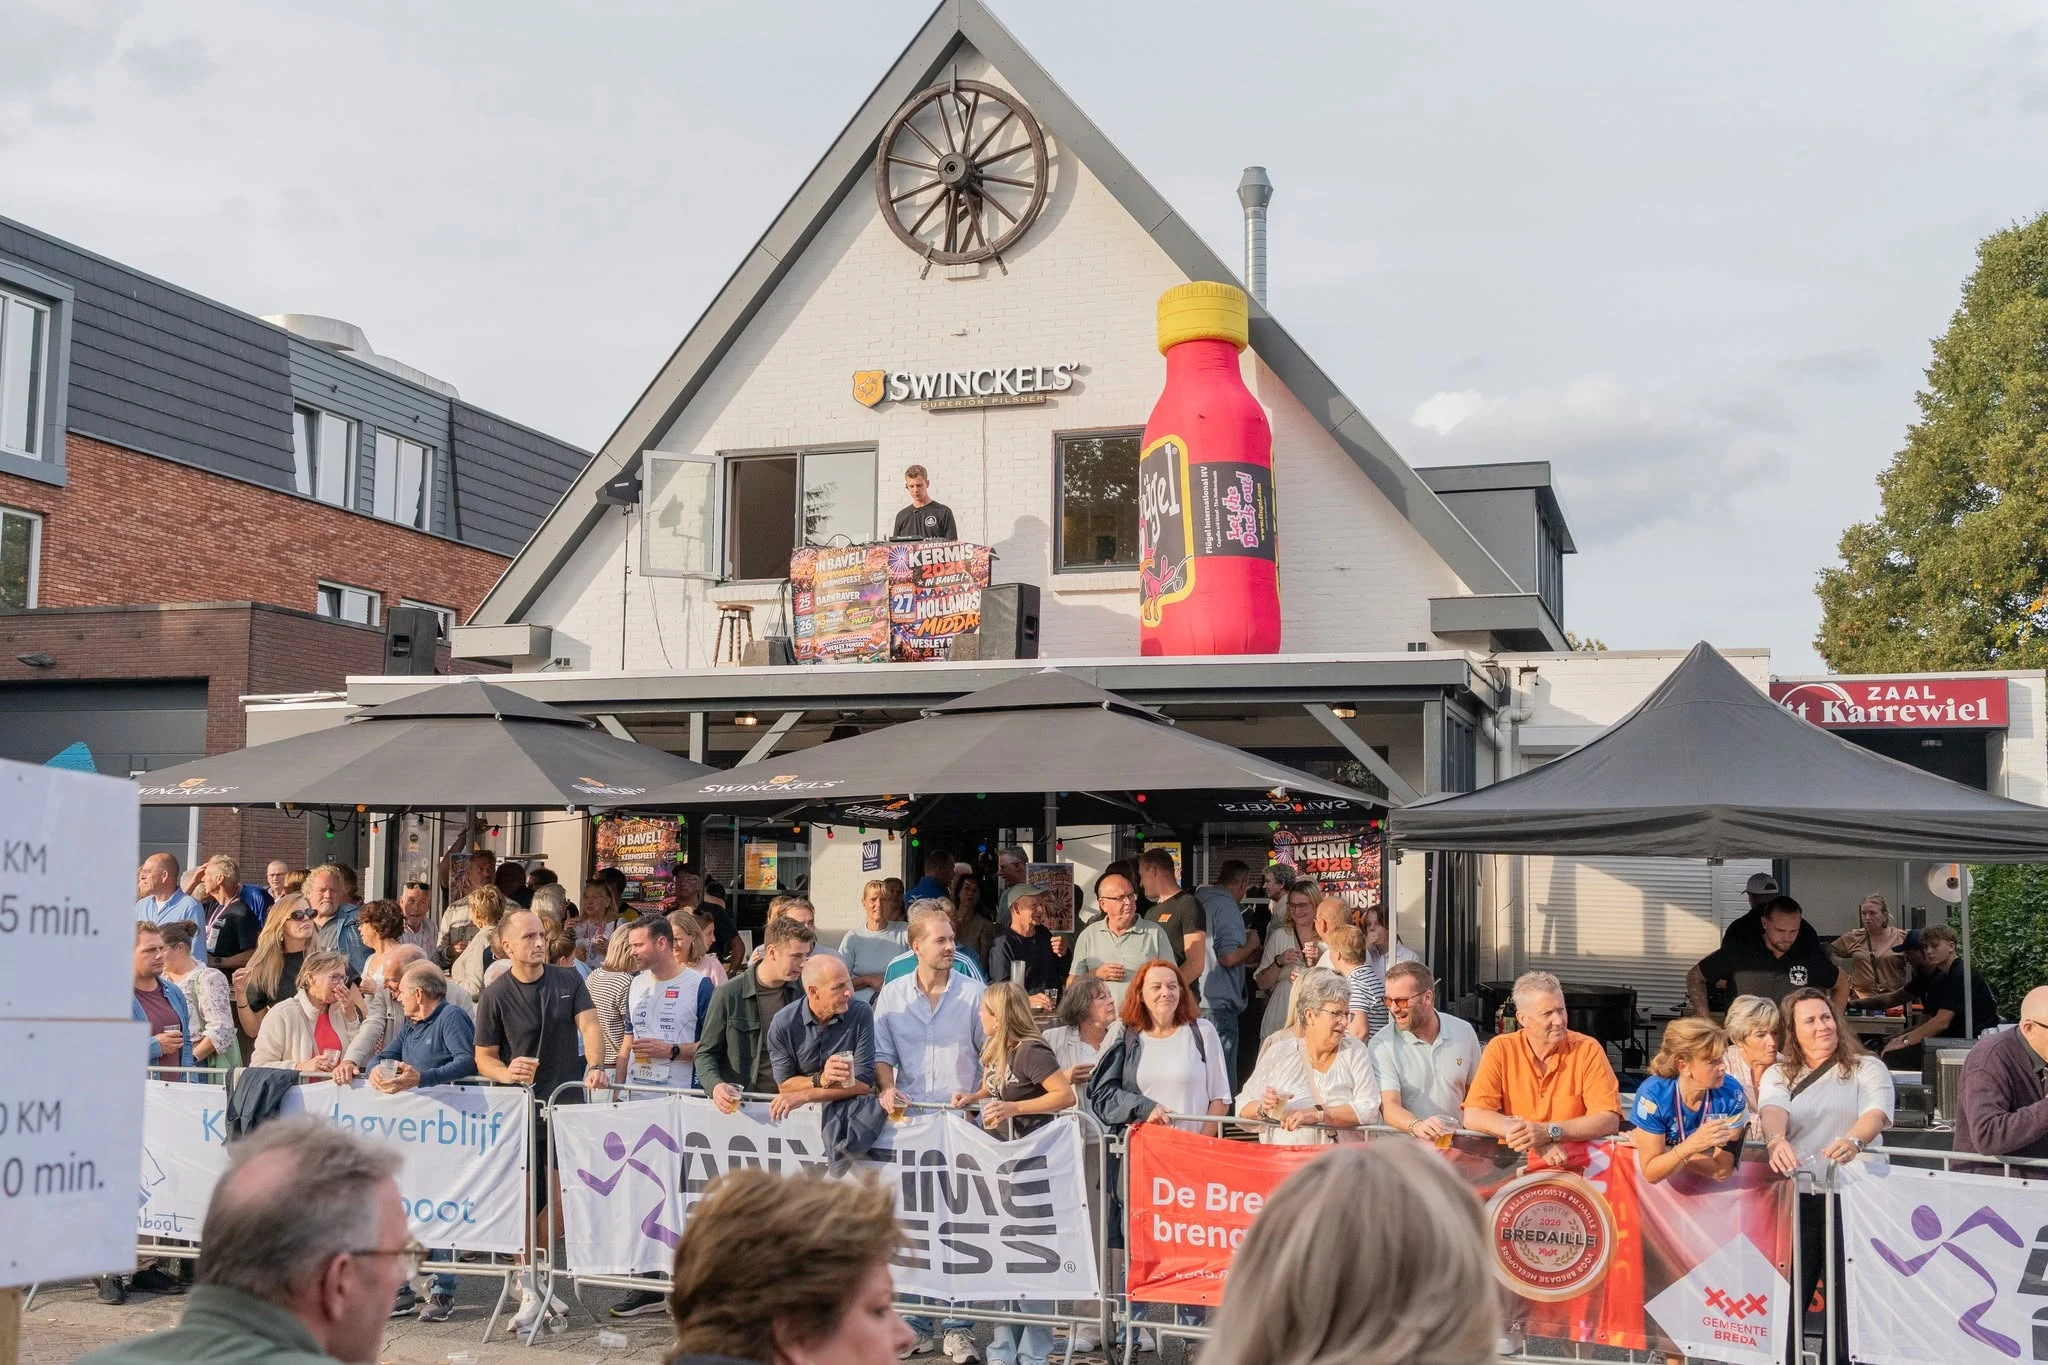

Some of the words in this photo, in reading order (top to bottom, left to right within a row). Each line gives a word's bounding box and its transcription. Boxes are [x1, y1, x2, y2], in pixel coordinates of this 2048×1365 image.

[889, 360, 1079, 401] SWINCKELS'
[921, 399, 985, 410] SUPERIOR
[992, 395, 1044, 404] PILSNER
[1200, 466, 1209, 478] NV
[1236, 471, 1253, 503] out!
[1201, 478, 1211, 529] International
[1222, 486, 1241, 512] the
[1226, 514, 1241, 540] Let
[1240, 504, 1259, 548] Duck
[1205, 529, 1214, 554] Flügel
[815, 560, 826, 573] IN
[828, 550, 867, 570] BAVEL!
[908, 543, 974, 568] KERMIS
[921, 560, 967, 579] 2026
[924, 576, 933, 587] IN
[936, 573, 964, 585] BAVEL!
[798, 597, 811, 609] 25
[815, 591, 860, 606] DARKRAVER
[893, 593, 914, 614] 27
[916, 590, 981, 620] HOLLANDS
[799, 619, 812, 631] 26
[800, 642, 811, 654] 27
[910, 638, 945, 649] WESLEY
[923, 648, 933, 657] &
[1867, 684, 1936, 701] ZAAL
[1821, 697, 1990, 723] Karrewiel
[698, 781, 844, 794] SWINCKELS'
[616, 835, 626, 846] IN
[627, 830, 662, 846] BAVEL!
[3, 840, 48, 875] KM
[1293, 842, 1363, 861] KERMIS
[1305, 857, 1353, 873] 2026
[1319, 870, 1350, 880] BAVEL!
[0, 894, 19, 933] 5
[30, 896, 100, 937] min.
[17, 1100, 62, 1134] KM
[3, 1157, 23, 1198] 0
[35, 1152, 104, 1195] min.
[1152, 1177, 1196, 1209] De
[1205, 1182, 1265, 1214] Bre
[1502, 1211, 1512, 1224] DE
[1510, 1188, 1569, 1212] ALLERMOOISTE
[1568, 1195, 1597, 1230] MEDAILLE
[1501, 1227, 1597, 1249] BREDAILLE
[1576, 1253, 1593, 1273] VOOR
[1539, 1271, 1577, 1284] BREDASE
[1702, 1316, 1768, 1337] GEMEENTE
[1713, 1330, 1758, 1347] BREDA
